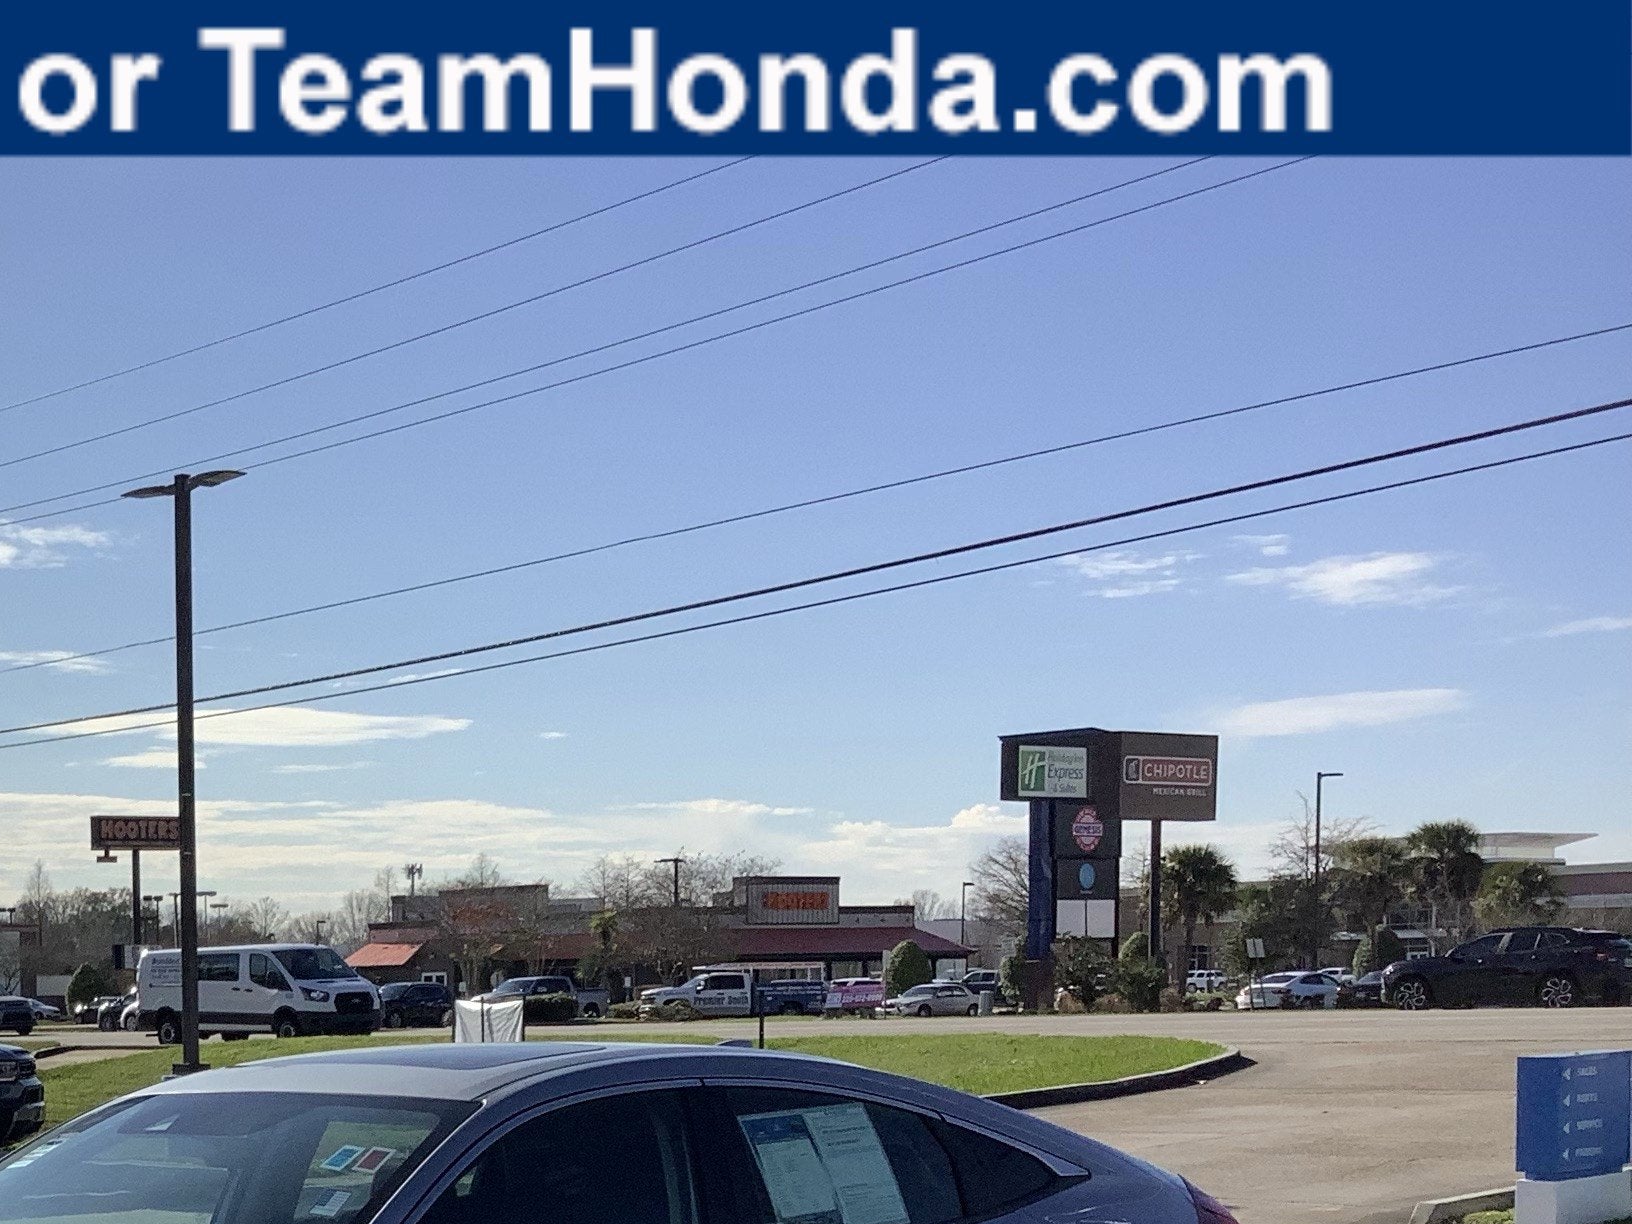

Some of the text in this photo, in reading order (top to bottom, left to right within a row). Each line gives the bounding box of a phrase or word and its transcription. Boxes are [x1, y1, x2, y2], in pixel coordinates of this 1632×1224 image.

[1048, 763, 1084, 781] Express
[1144, 763, 1208, 779] CHIPOTLE
[1152, 787, 1207, 796] MEXICAN GRILL
[100, 820, 179, 840] HOOTERS
